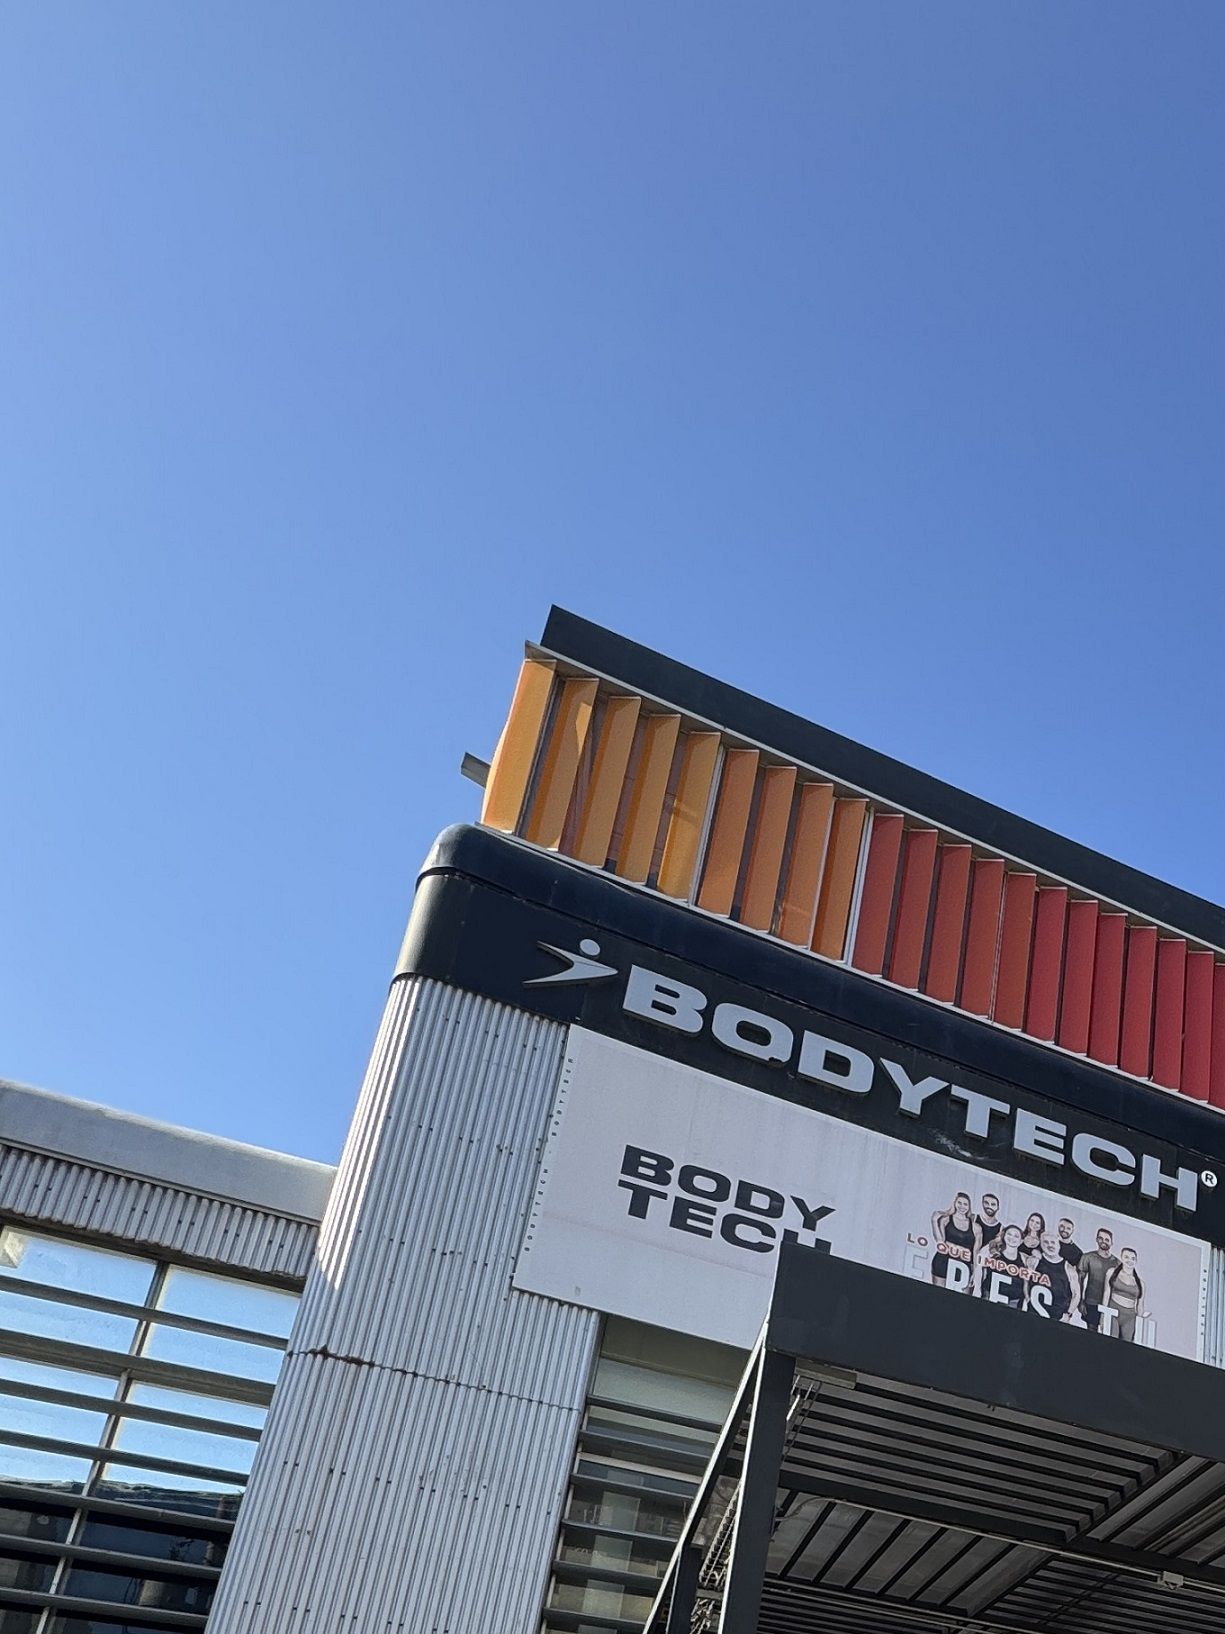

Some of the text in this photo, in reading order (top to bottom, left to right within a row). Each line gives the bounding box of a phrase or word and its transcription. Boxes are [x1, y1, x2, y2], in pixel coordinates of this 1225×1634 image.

[619, 1144, 837, 1232] BODY
[906, 1232, 1052, 1287] LO QUE IMPORTA
